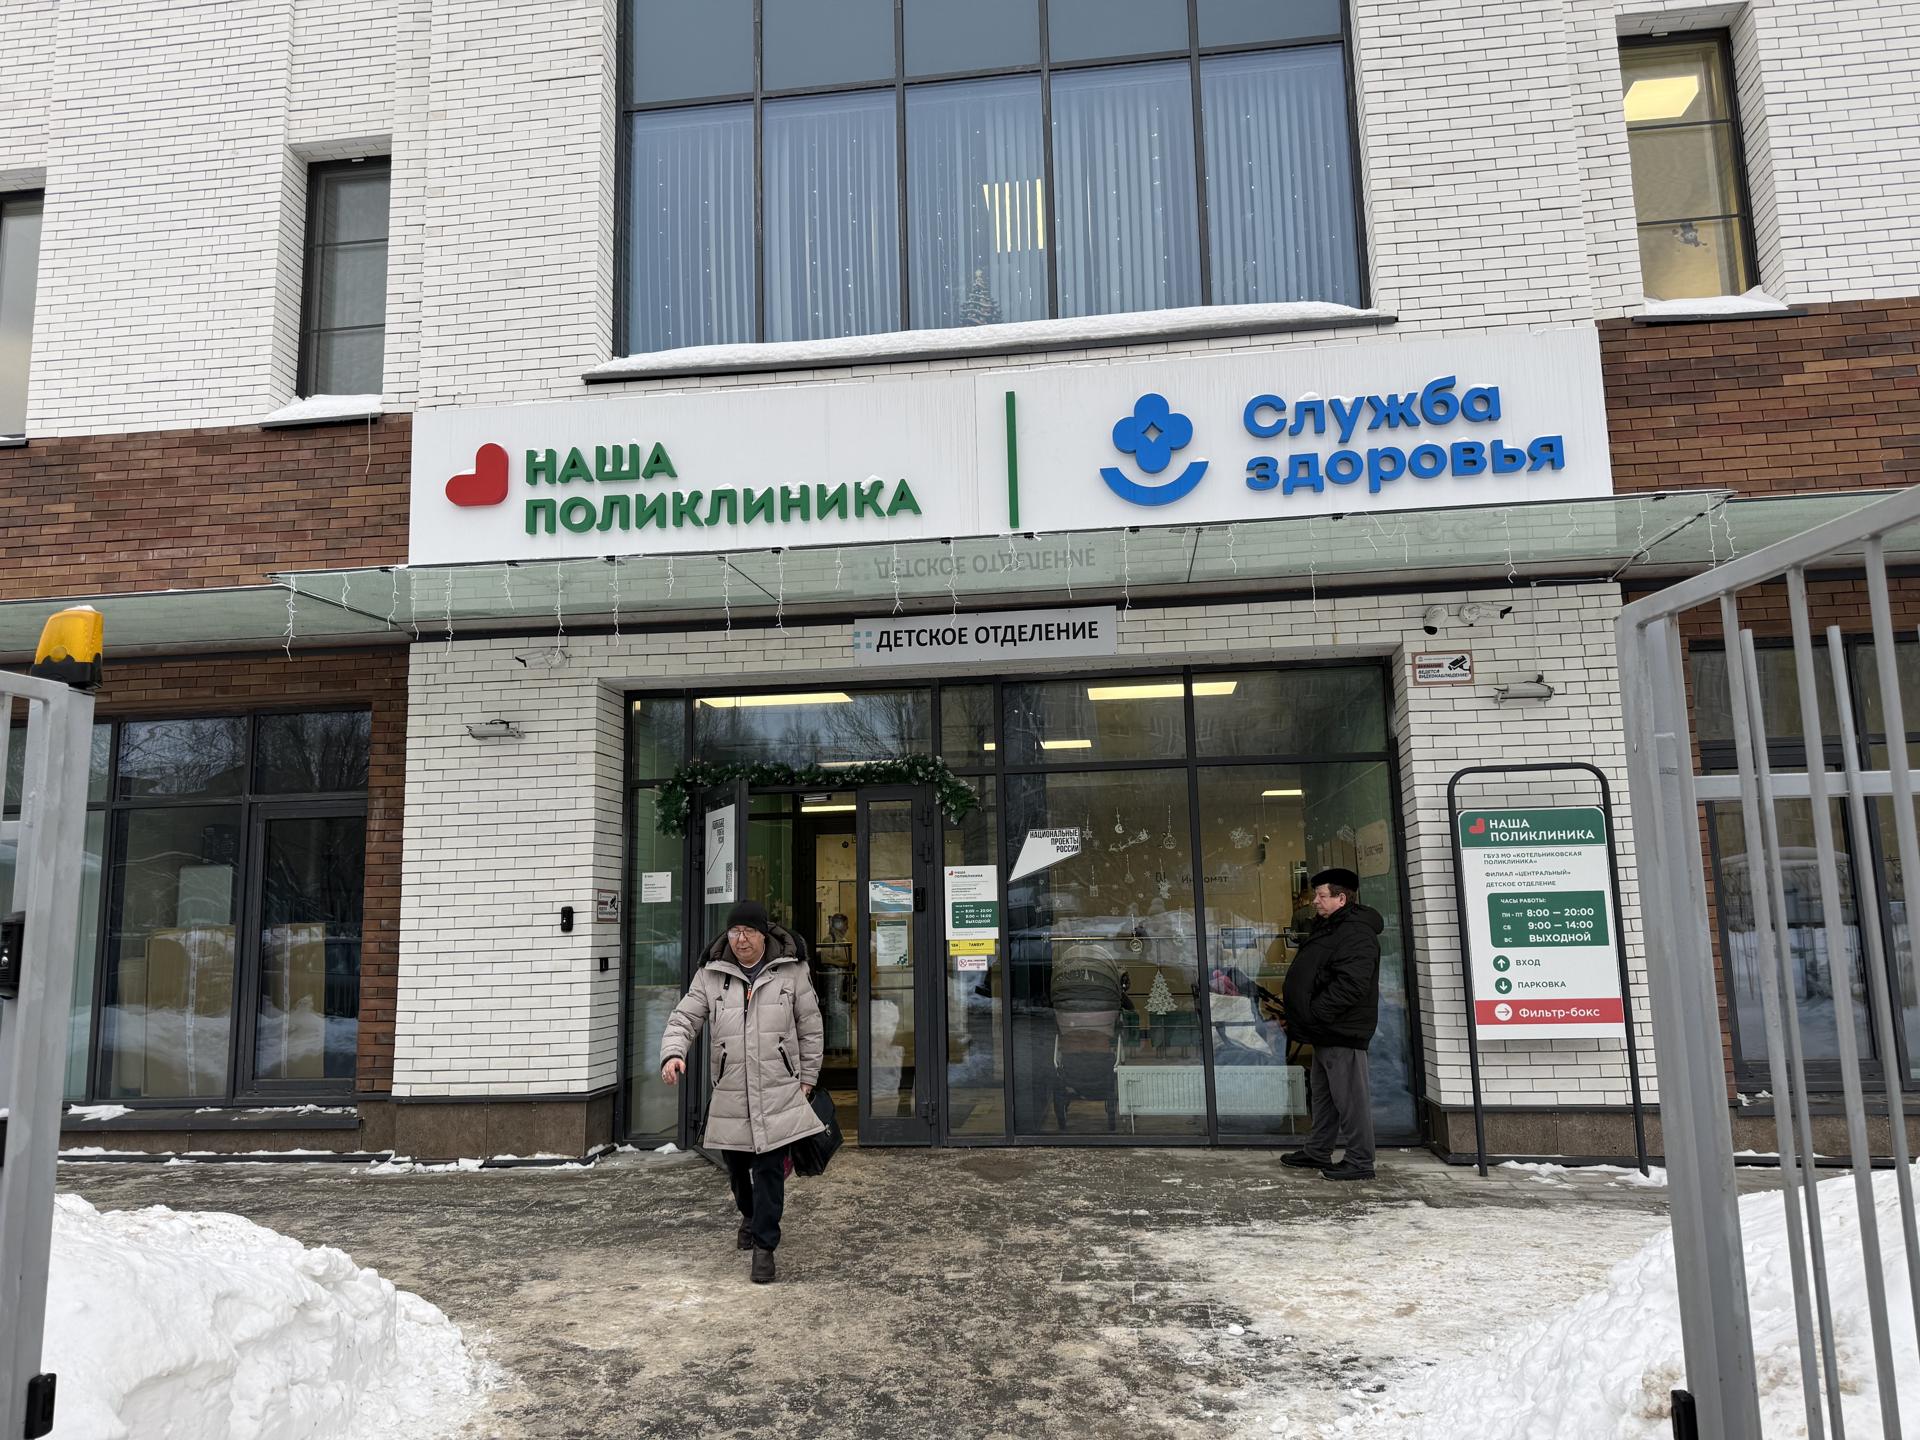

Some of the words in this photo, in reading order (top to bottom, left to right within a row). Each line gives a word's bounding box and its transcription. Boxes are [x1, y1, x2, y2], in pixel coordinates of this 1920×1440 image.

[1243, 375, 1502, 444] Служба
[525, 441, 678, 486] НАША
[1245, 434, 1565, 495] здоровья
[524, 477, 922, 535] ПОЛИКЛИНИКА
[876, 627, 968, 652] ДЕТСКОЕ
[974, 621, 1099, 646] ОТДЕЛЕНИЕ
[1489, 818, 1530, 829] НАША
[1030, 829, 1078, 839] НАЦИОНАЛЬНЫЕ
[1490, 830, 1595, 842] ПОЛИКЛИНИКА
[1050, 837, 1079, 846] ПРОЕКТЫ
[1056, 845, 1079, 853] РОССИИ
[1526, 908, 1550, 917] 8:00
[1564, 908, 1594, 917] 20:00
[1528, 921, 1551, 930] 9:00
[1565, 920, 1593, 929] 14:00
[1529, 932, 1592, 943] ВЫХОДНОЙ
[1515, 959, 1541, 967] ВХОД
[1519, 1007, 1600, 1019] Фильтр-бокс
